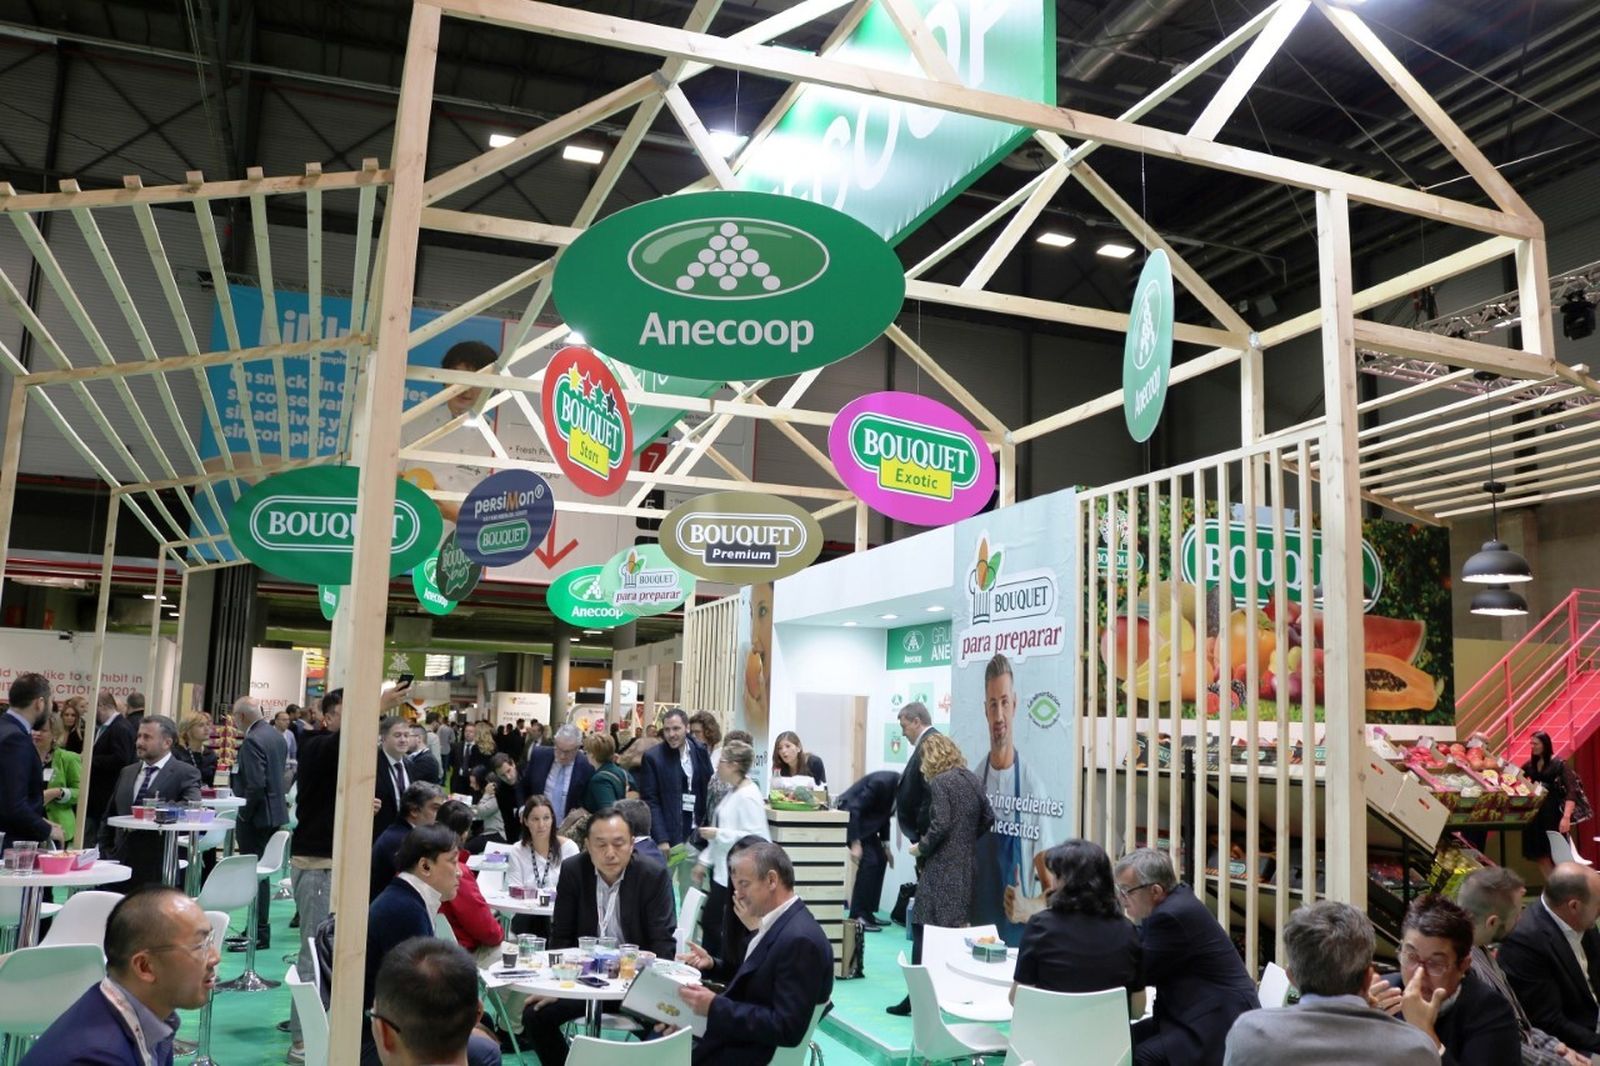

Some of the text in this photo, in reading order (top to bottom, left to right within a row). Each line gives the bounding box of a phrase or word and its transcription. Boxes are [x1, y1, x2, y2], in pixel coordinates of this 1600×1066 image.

[634, 312, 814, 352] Anecoop
[255, 373, 307, 389] snck
[561, 391, 620, 452] BOUQUET
[580, 441, 600, 464] Stars
[648, 452, 660, 471] 7
[864, 428, 969, 475] BOUQUET
[896, 468, 939, 490] Exotic
[482, 527, 526, 547] BOUQUET
[690, 524, 795, 547] BOUQUET
[712, 548, 771, 561] Premium
[639, 574, 674, 585] BOUQUET
[616, 590, 681, 602] para preparar
[995, 586, 1049, 613] BOUQUET
[571, 606, 624, 619] Anecoop
[931, 626, 951, 645] GRU
[962, 626, 1062, 660] para preparar
[930, 643, 952, 661] ANE
[69, 671, 82, 681] to
[86, 673, 128, 683] ehibit
[132, 675, 143, 683] in
[995, 790, 1063, 817] ingredientes
